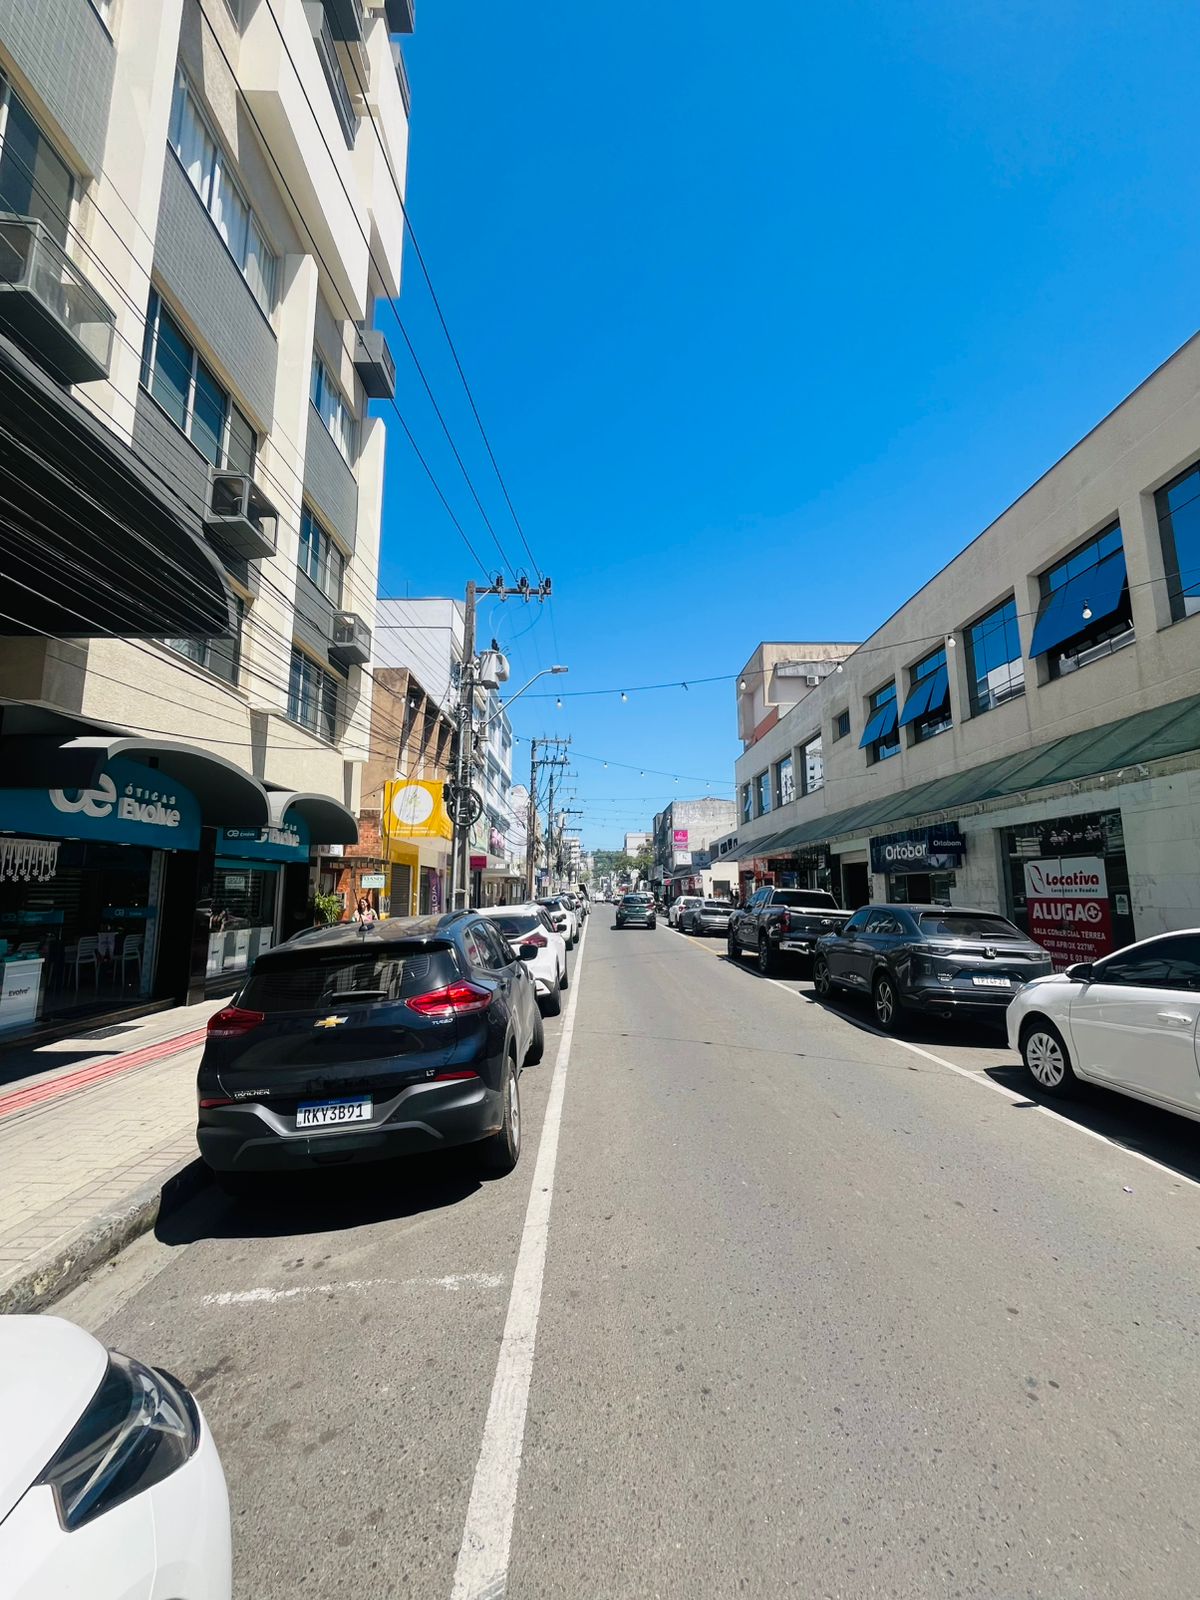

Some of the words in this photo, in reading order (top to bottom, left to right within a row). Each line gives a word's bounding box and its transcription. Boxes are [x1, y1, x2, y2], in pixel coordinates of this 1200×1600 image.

[125, 783, 176, 805] ÓTICAS
[117, 797, 180, 827] Evolve
[1046, 870, 1100, 886] Locativa
[303, 1103, 363, 1124] RKY3B91
